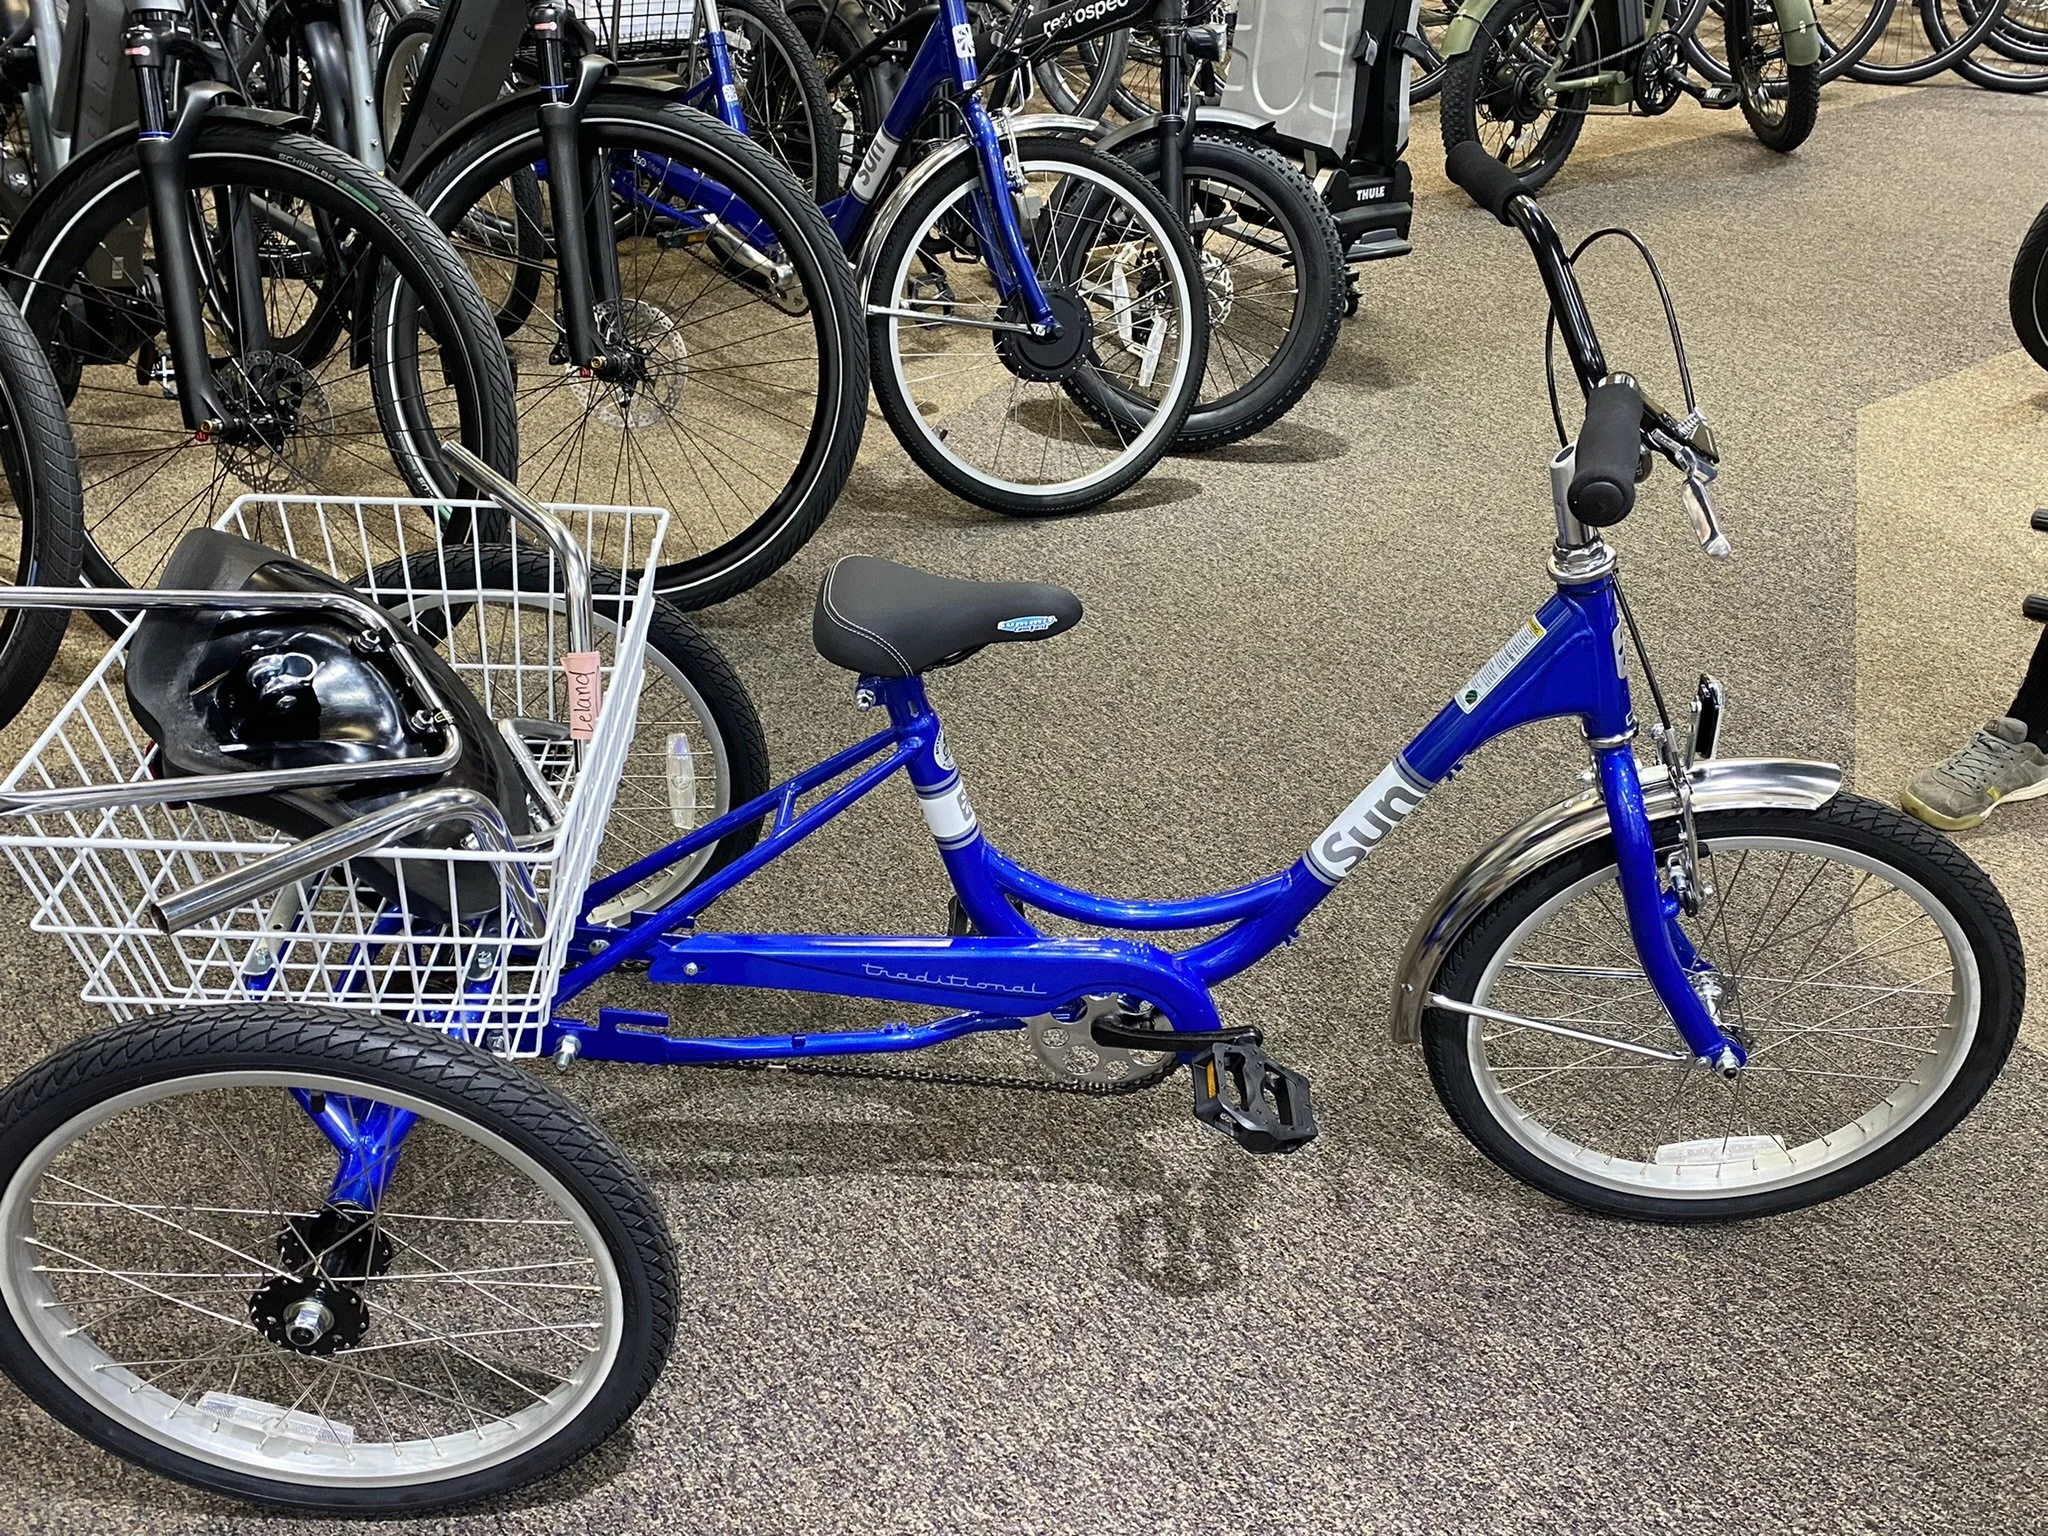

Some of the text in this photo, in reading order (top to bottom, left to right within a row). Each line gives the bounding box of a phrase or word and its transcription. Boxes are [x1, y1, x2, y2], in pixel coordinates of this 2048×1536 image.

[276, 152, 336, 182] SCHWALBE
[1356, 185, 1386, 202] THULE
[568, 666, 596, 732] Leland
[861, 962, 1048, 995] traditional
